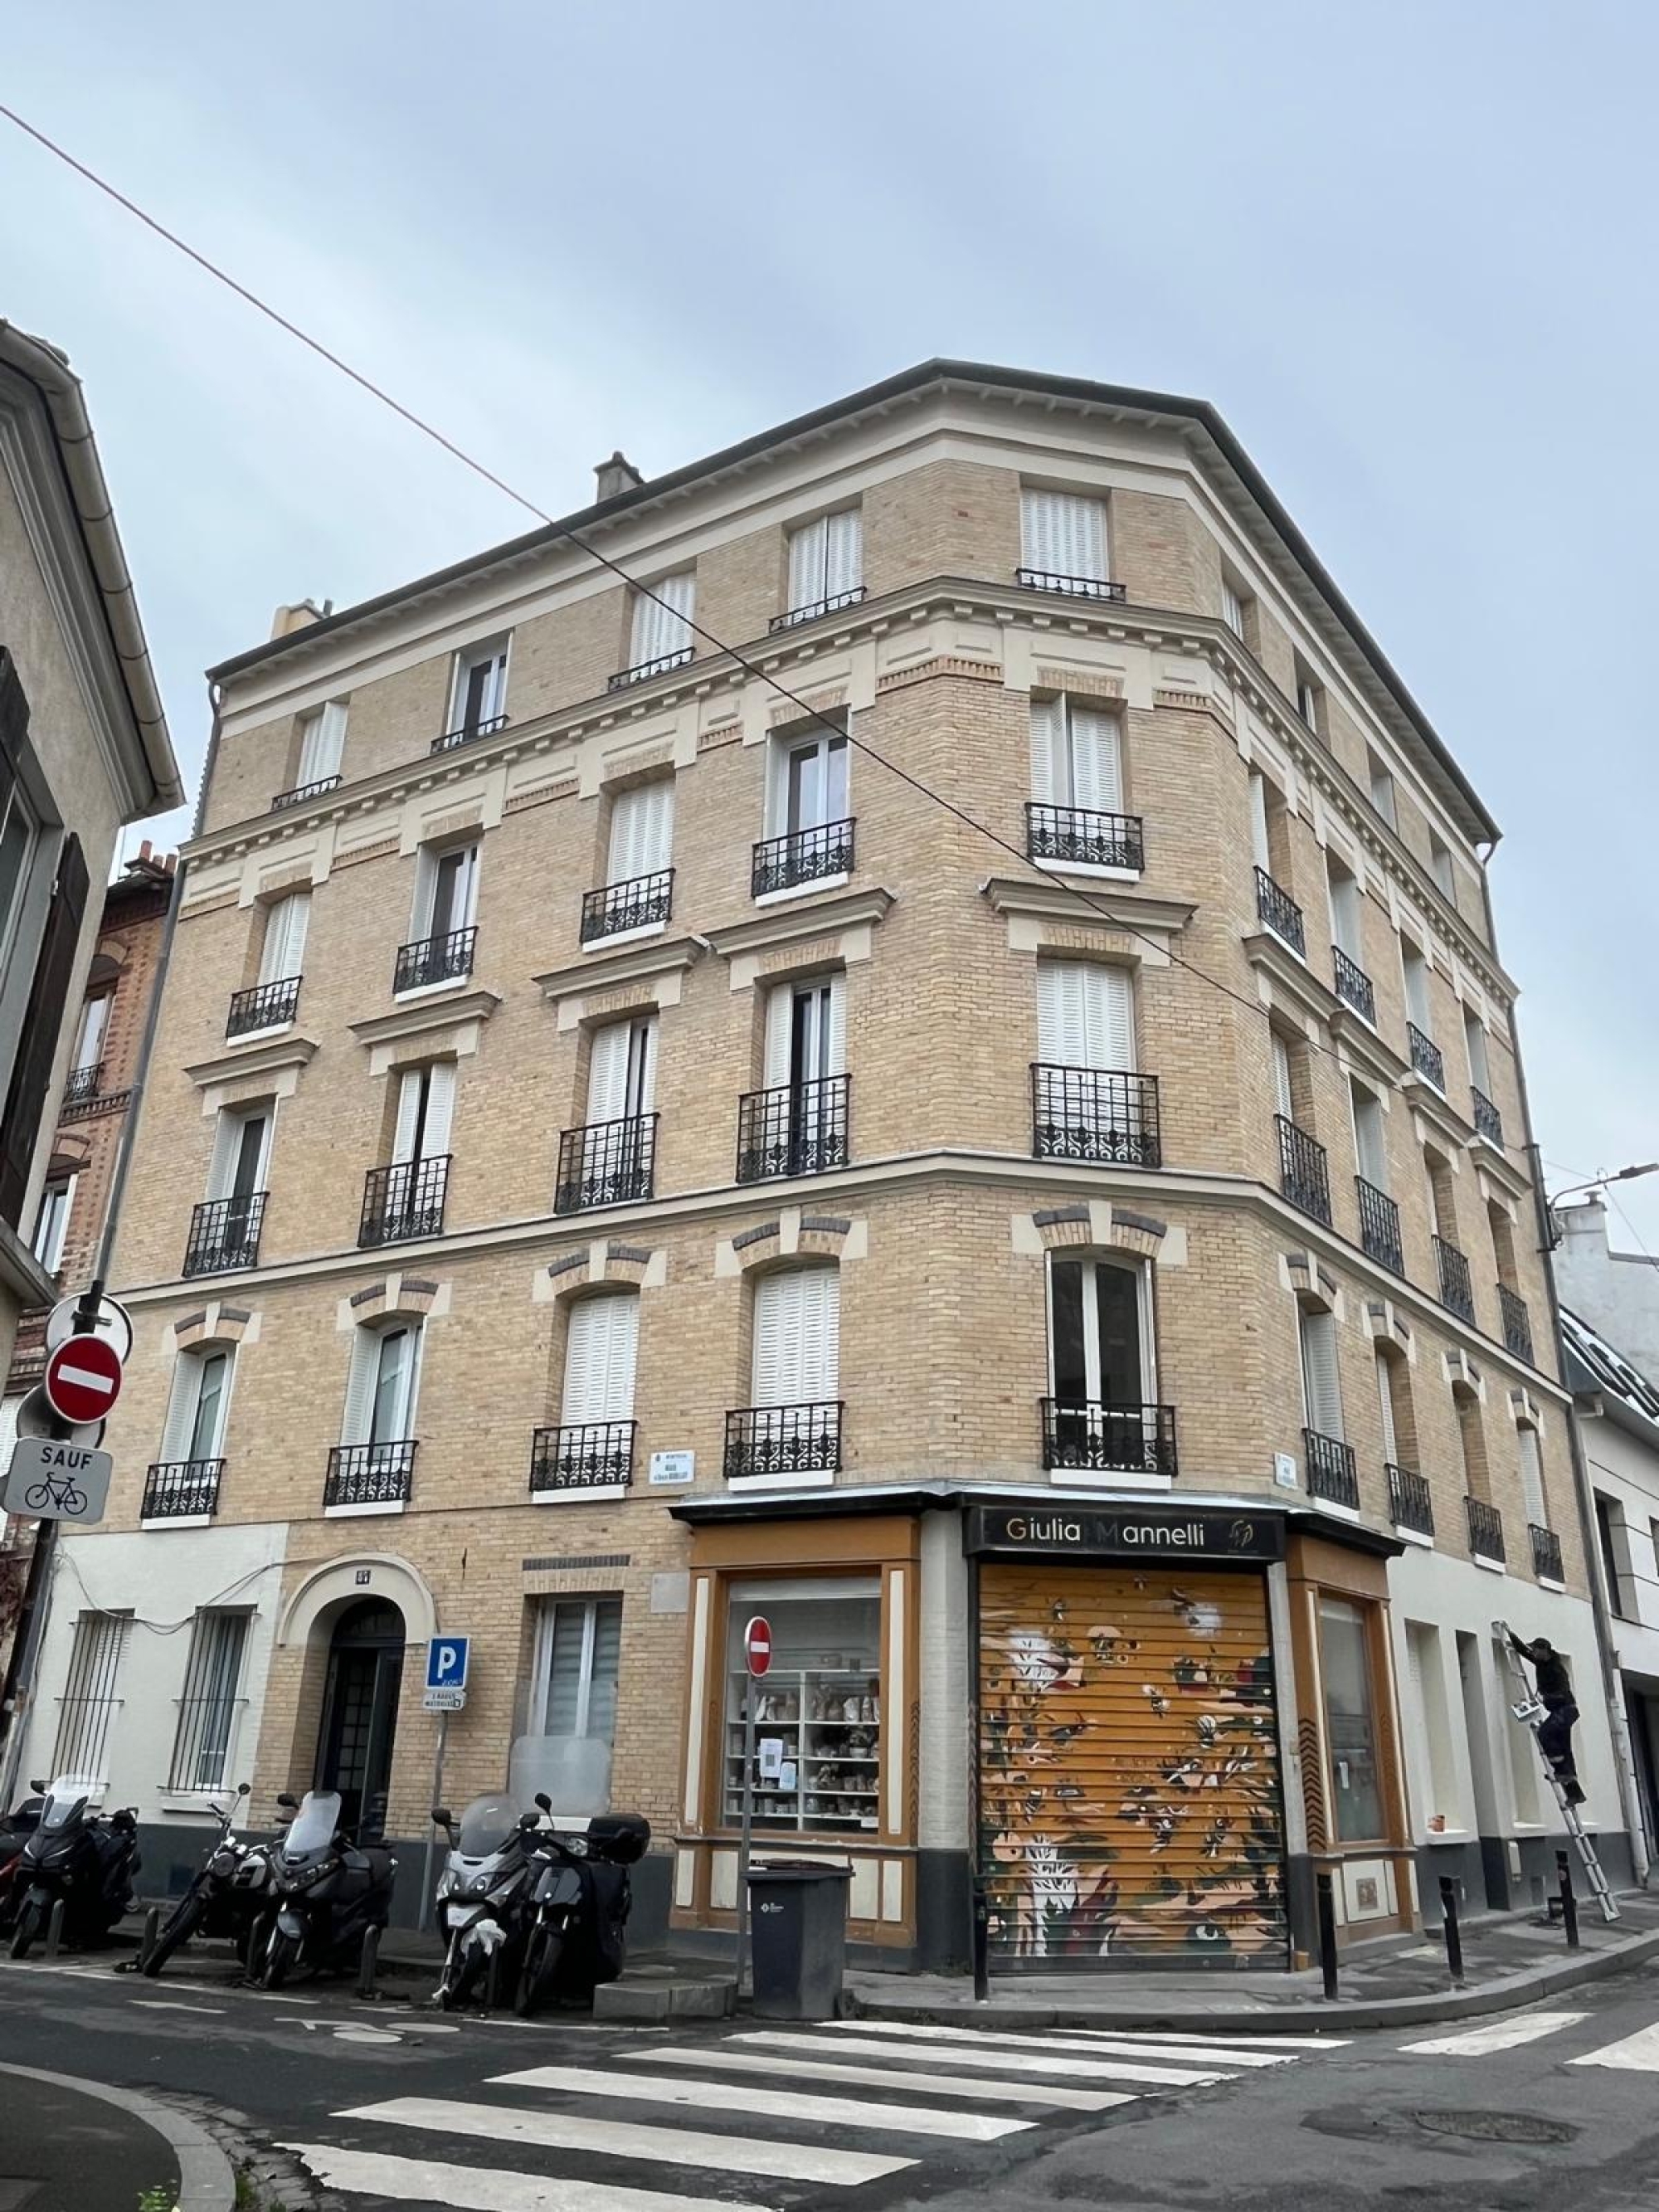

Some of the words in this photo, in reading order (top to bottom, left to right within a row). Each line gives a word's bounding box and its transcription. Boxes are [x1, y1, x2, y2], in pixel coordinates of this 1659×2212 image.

[40, 1446, 93, 1469] SAUF
[1006, 1517, 1081, 1541] Giulia
[437, 1646, 457, 1679] P
